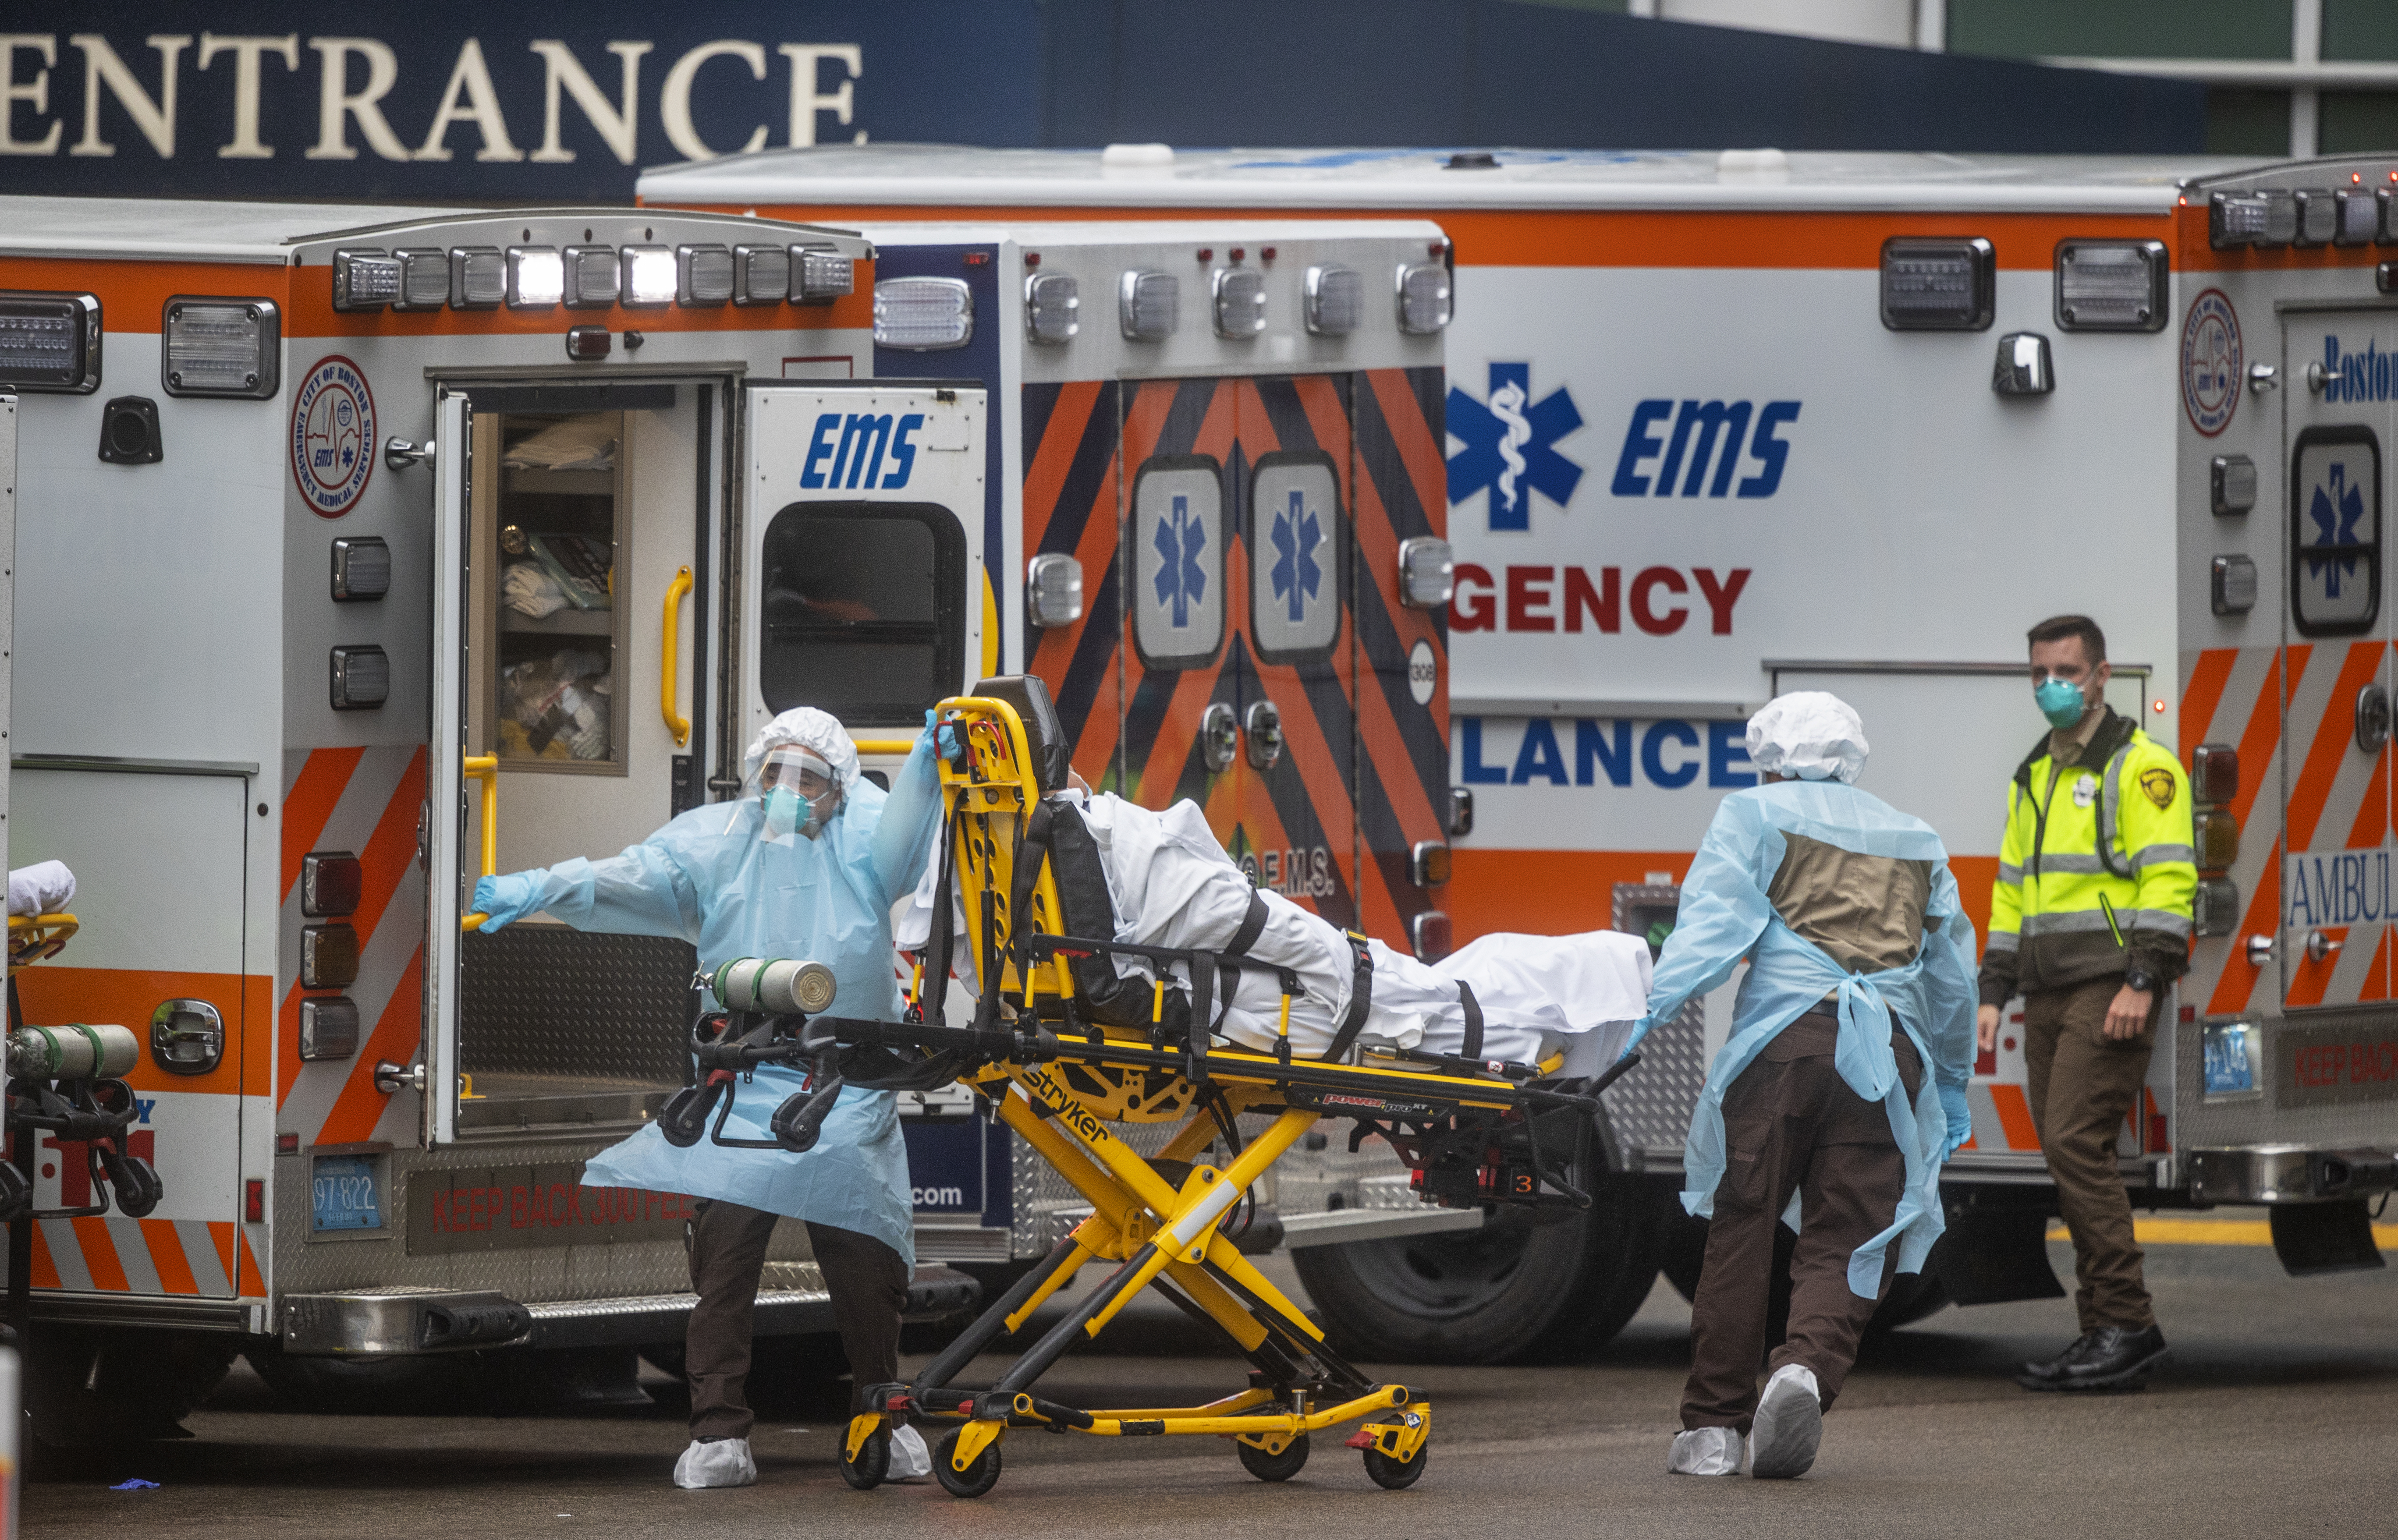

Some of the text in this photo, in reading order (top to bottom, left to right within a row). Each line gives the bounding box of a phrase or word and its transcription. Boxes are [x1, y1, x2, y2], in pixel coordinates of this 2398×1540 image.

[0, 30, 868, 165] ENTRANCE
[302, 366, 369, 413] CITY OF BOSTON
[296, 411, 371, 507] EMERGENCY MEDICAL SERVICES
[314, 448, 334, 467] EMS
[799, 414, 925, 490] EMS
[1611, 399, 1802, 499] EMS
[2295, 1045, 2345, 1087] KEEP
[1022, 1070, 1108, 1142] stryker
[433, 1187, 503, 1233] KEEP
[511, 1183, 584, 1228] BACK
[591, 1186, 638, 1225] 300
[1516, 1175, 1531, 1192] 3
